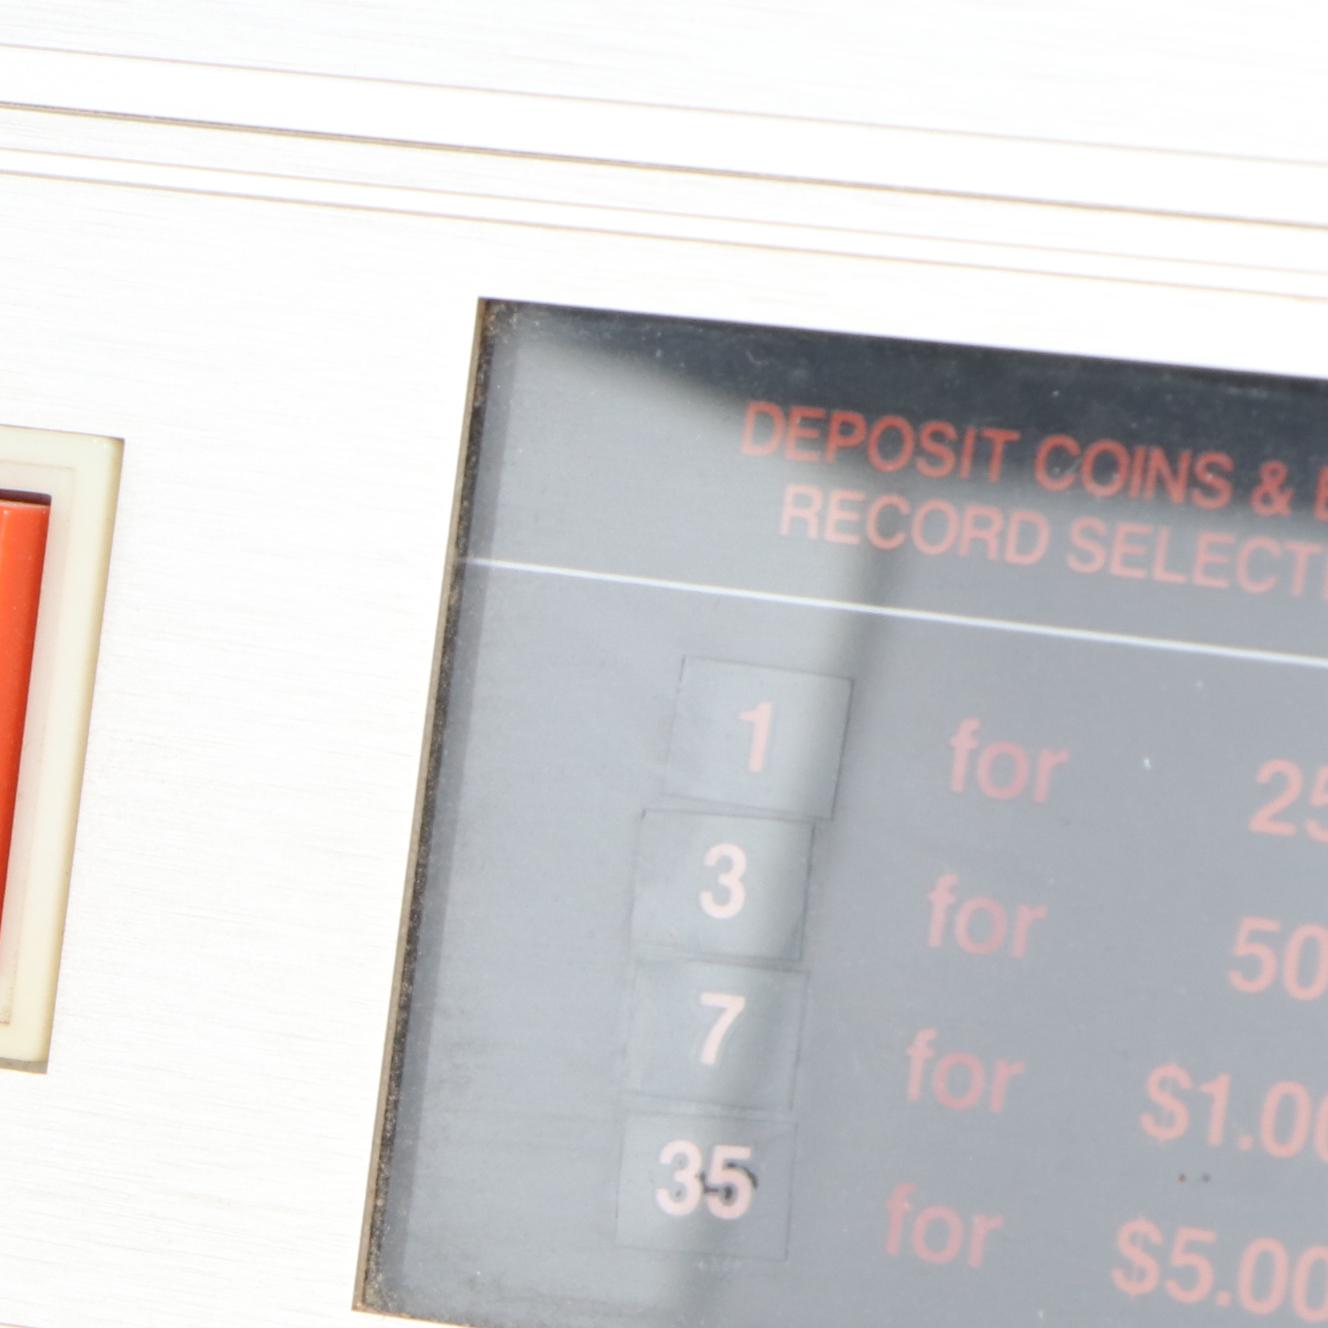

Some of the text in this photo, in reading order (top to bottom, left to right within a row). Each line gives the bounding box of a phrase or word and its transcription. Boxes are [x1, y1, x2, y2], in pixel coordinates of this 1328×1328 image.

[740, 400, 1021, 485] DEPOSIT
[1033, 433, 1235, 511] COINS
[1249, 460, 1294, 518] &
[778, 484, 1050, 567] RECORD
[737, 699, 775, 773] 1
[947, 717, 1071, 804] for
[697, 842, 748, 920] 3
[924, 873, 1048, 959] for
[696, 990, 746, 1067] 7
[903, 1028, 1027, 1114] for
[654, 1138, 756, 1221] 35
[882, 1182, 1005, 1269] for
